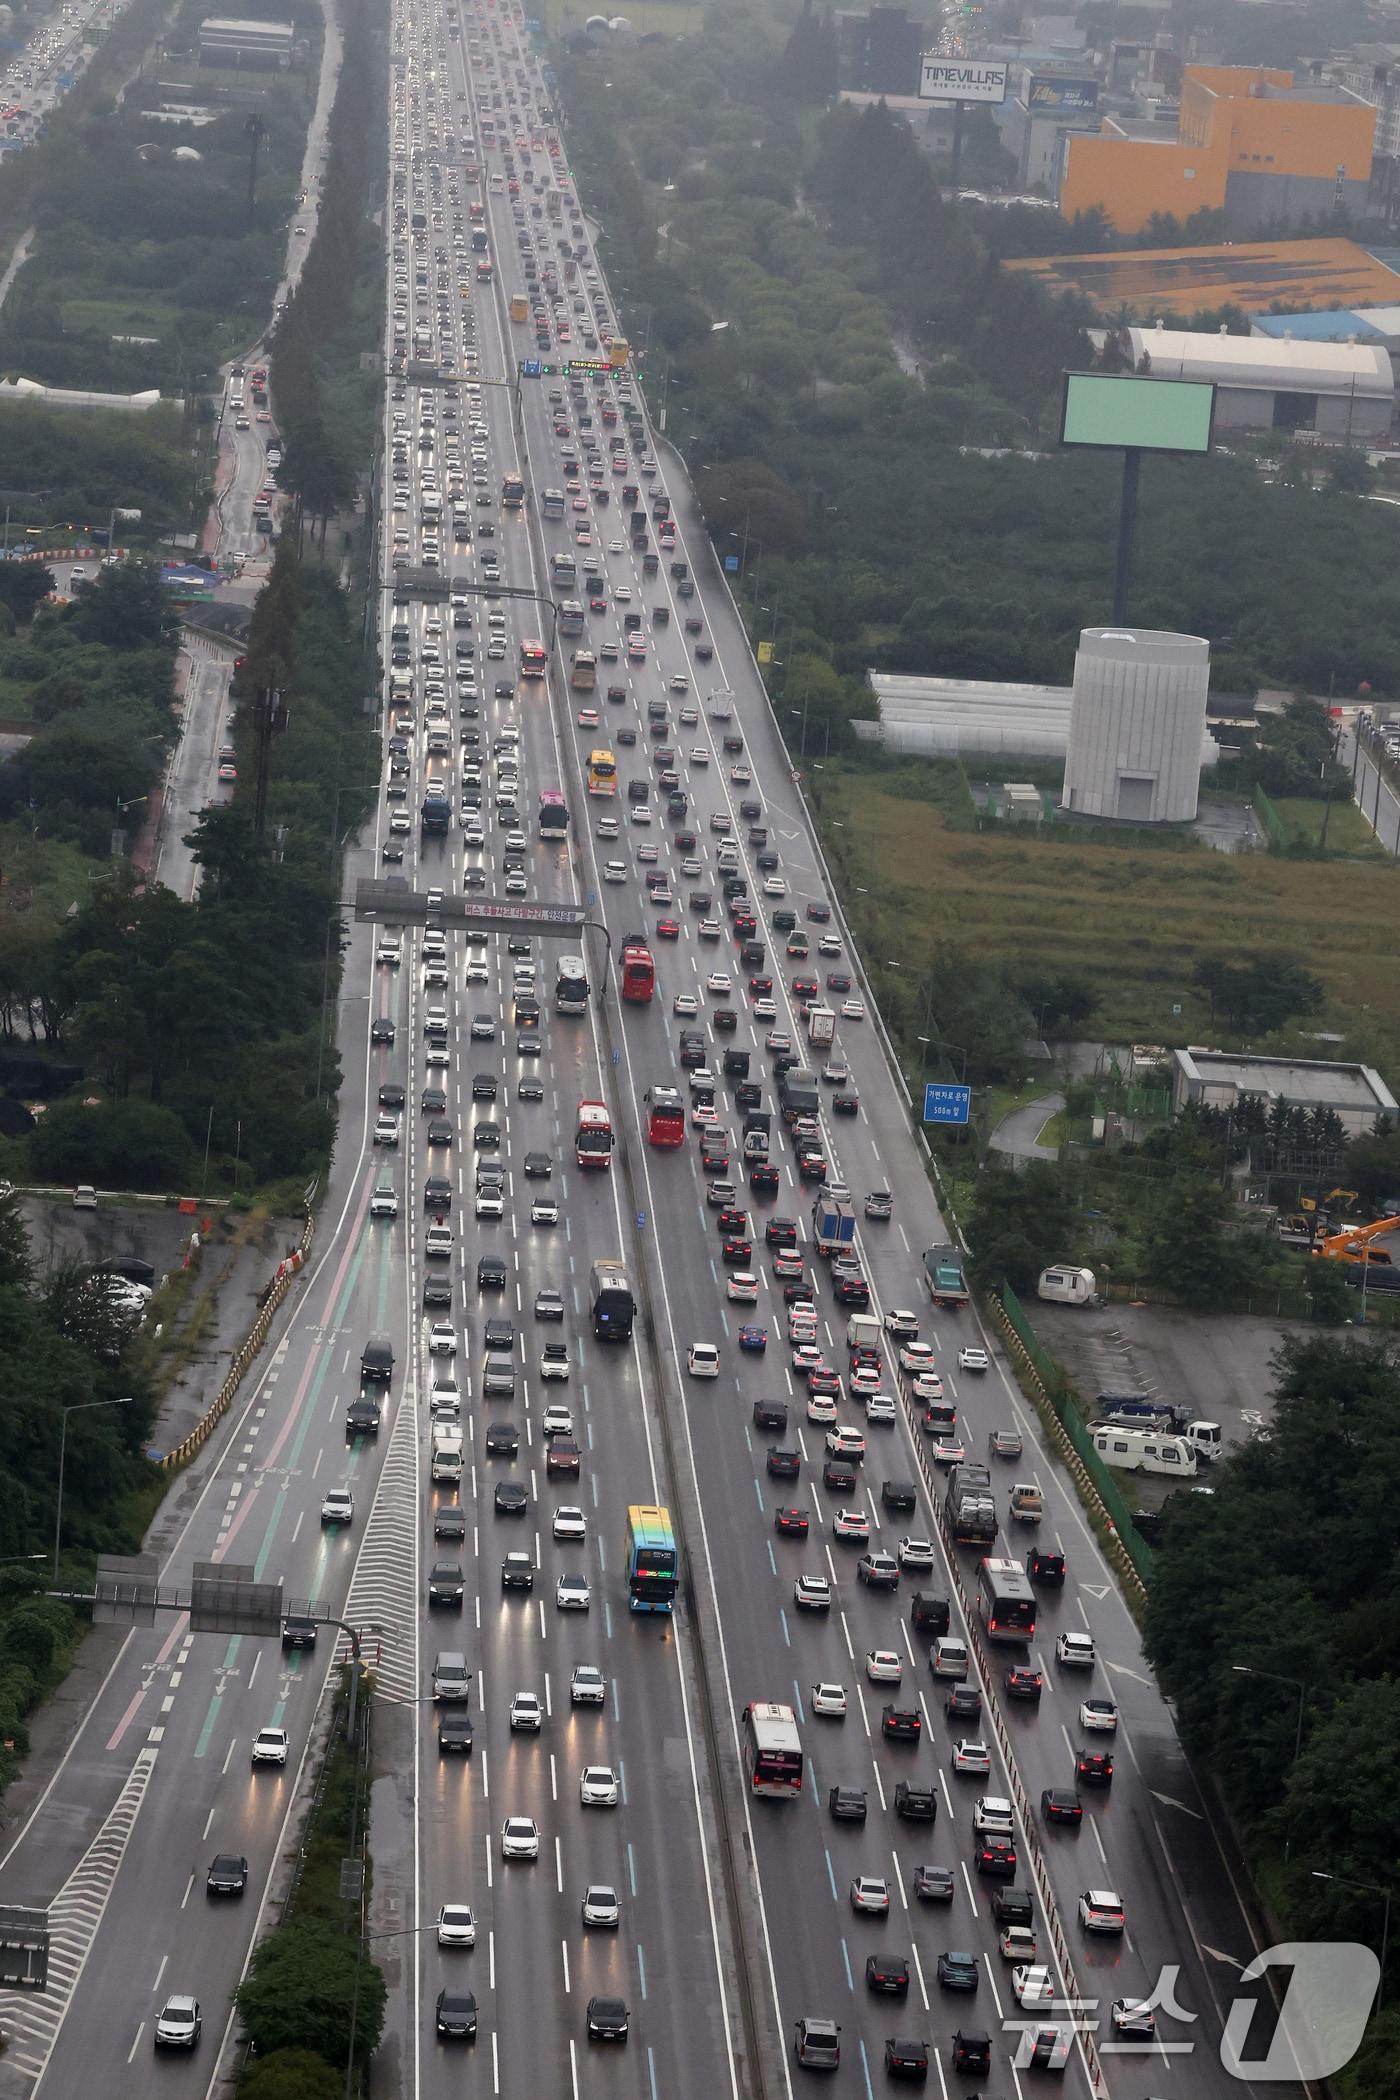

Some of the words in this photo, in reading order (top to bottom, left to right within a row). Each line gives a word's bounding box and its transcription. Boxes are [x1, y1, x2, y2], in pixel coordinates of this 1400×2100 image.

[924, 66, 1005, 85] TIMEVILLAS
[466, 904, 481, 915] 버스
[483, 905, 512, 917] 추돌사고
[547, 910, 577, 922] 안전운행
[928, 1090, 953, 1099] 가변차로
[955, 1092, 967, 1101] 운영
[934, 1106, 951, 1115] 500m
